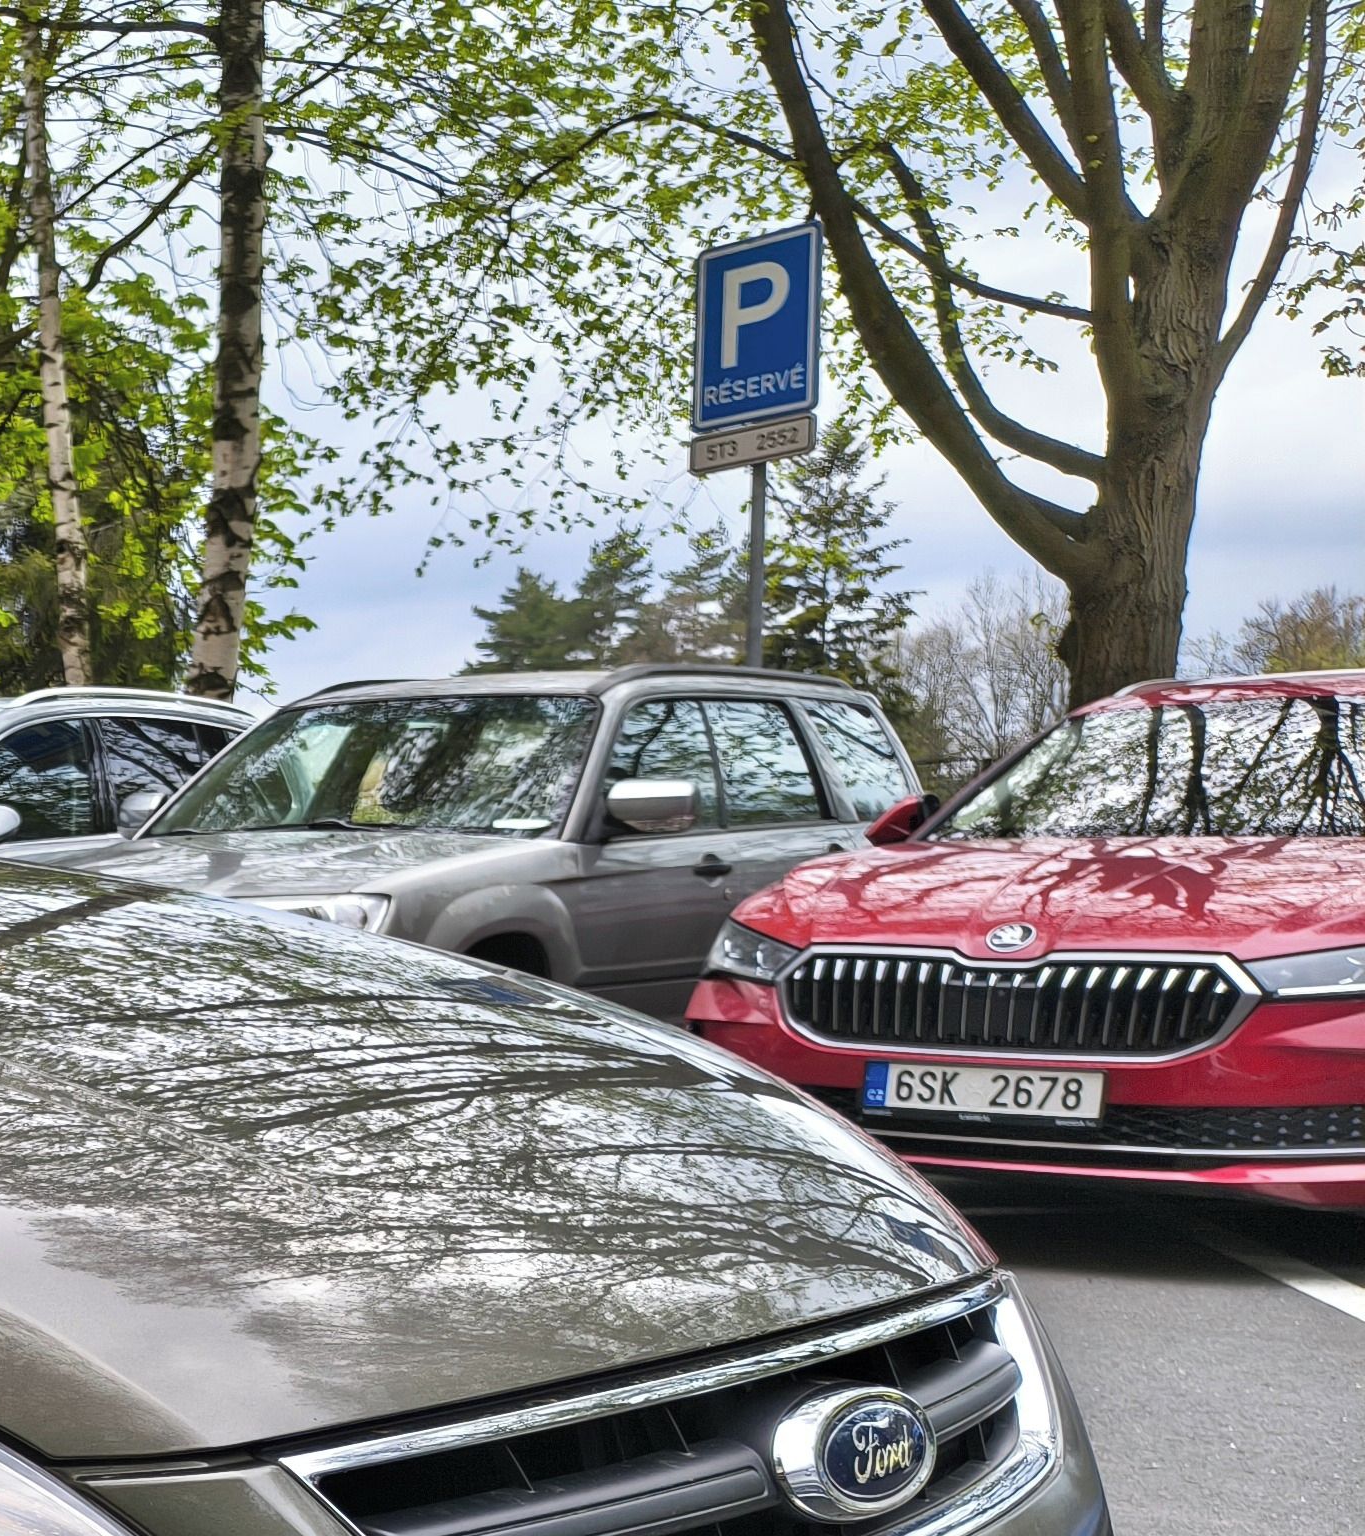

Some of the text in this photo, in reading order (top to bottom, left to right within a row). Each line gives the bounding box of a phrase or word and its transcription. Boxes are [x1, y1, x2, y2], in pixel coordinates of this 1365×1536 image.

[721, 261, 790, 369] P
[703, 362, 806, 408] RÉSERVÉ
[895, 1069, 1084, 1111] 6SK 2678
[852, 1416, 914, 1485] Ford
